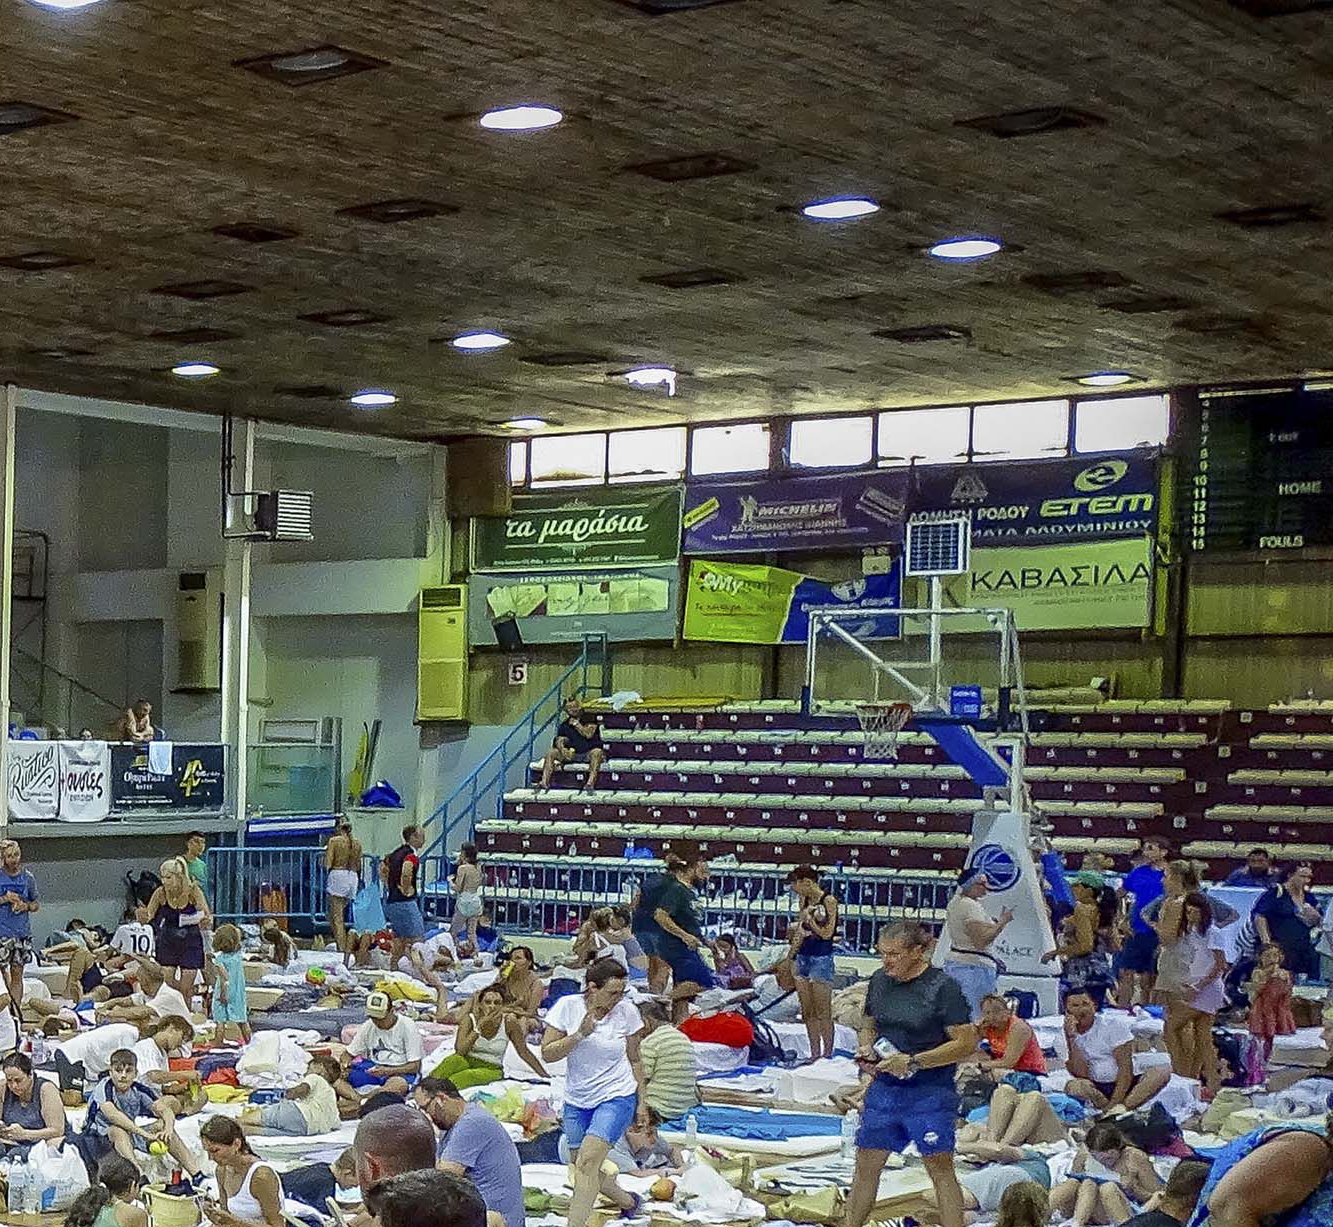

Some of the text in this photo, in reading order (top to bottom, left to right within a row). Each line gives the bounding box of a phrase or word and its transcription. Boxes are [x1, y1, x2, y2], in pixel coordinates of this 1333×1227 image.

[1278, 481, 1323, 496] HOME
[757, 502, 838, 517] MICHELIN
[977, 505, 1030, 521] ΡΟΔΟΥ
[505, 516, 537, 538] τα
[1259, 534, 1304, 549] FOULS
[512, 663, 524, 682] 5
[130, 934, 151, 954] 10
